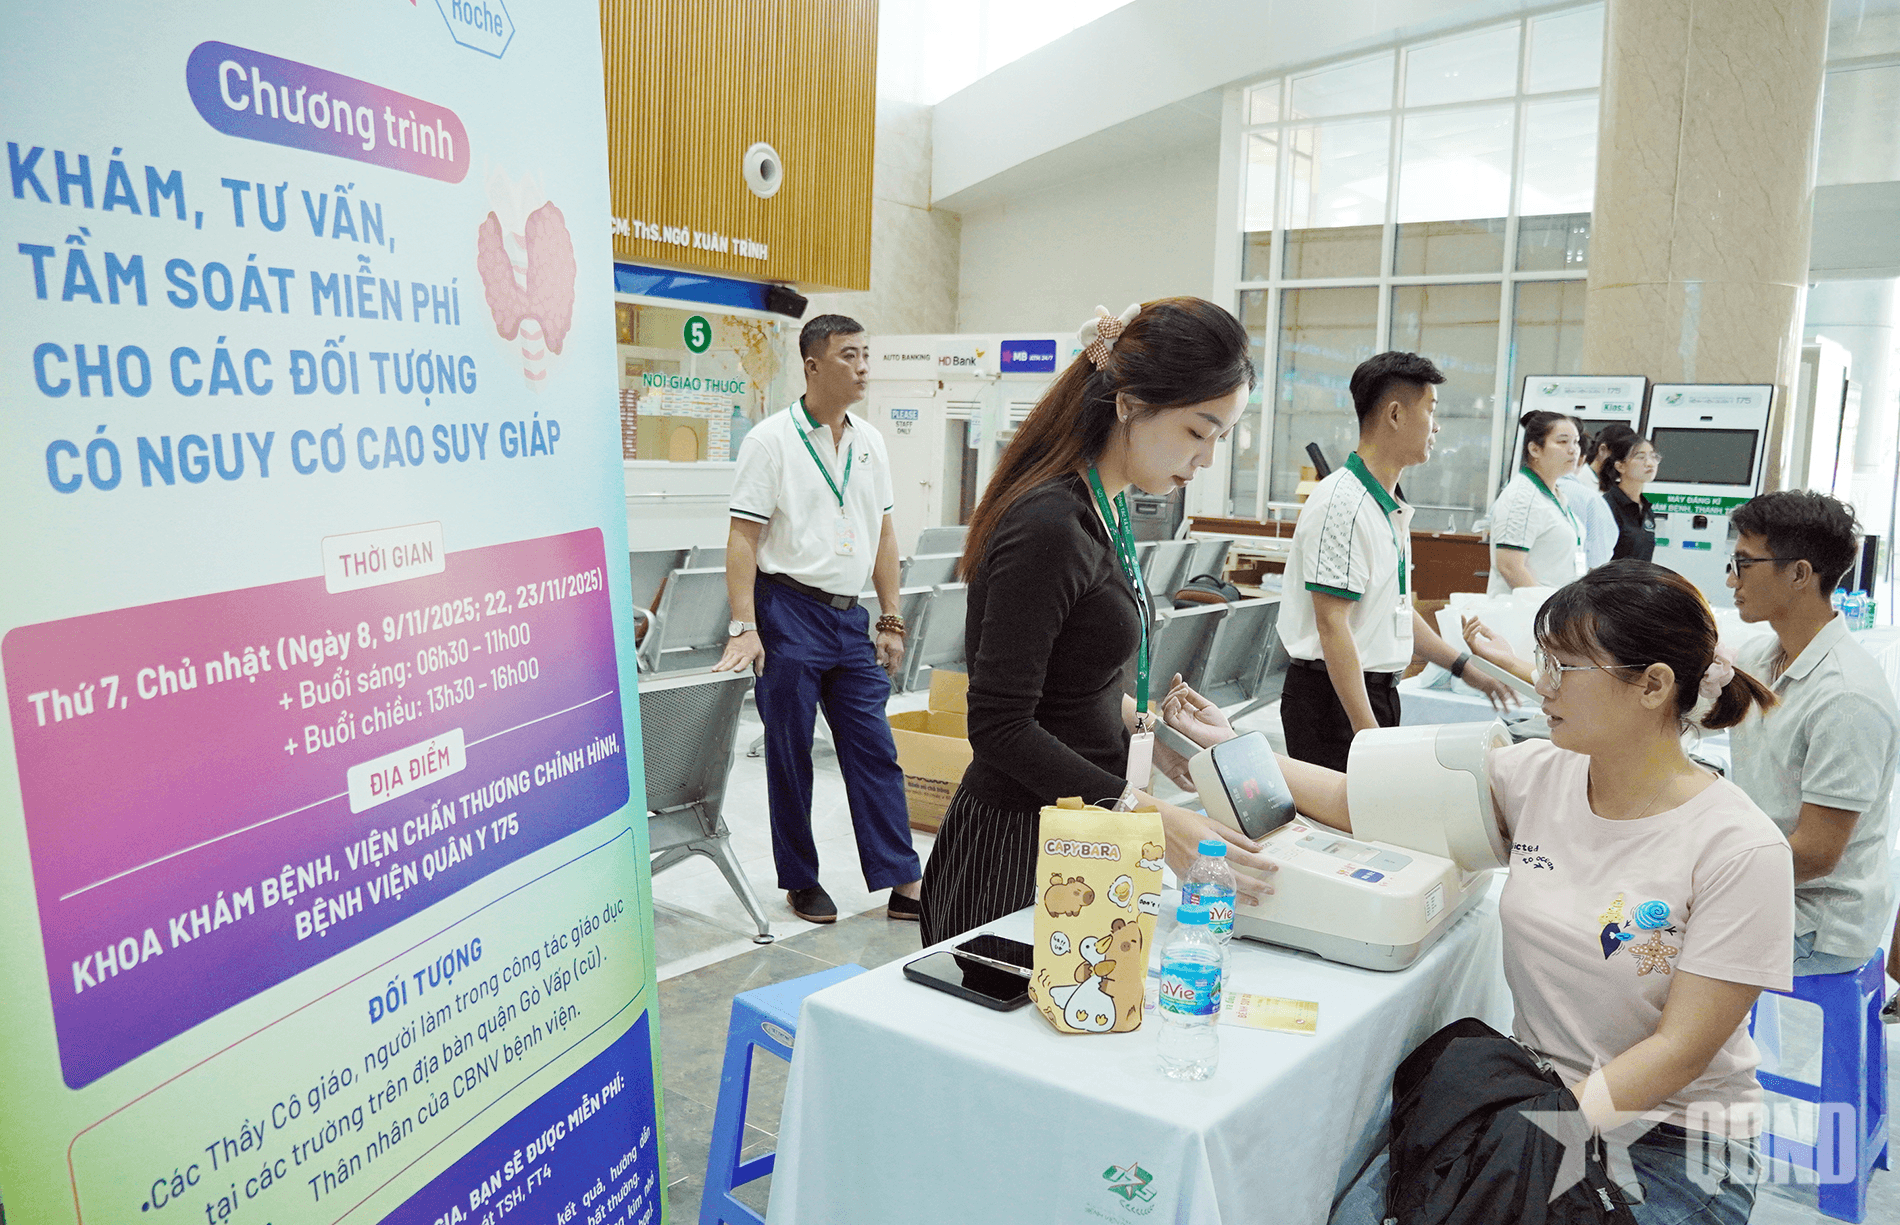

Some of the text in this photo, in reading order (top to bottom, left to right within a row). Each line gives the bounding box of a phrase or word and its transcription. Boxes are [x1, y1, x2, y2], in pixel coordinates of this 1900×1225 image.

[452, 0, 503, 37] Roche
[218, 60, 454, 162] Chương trình
[7, 141, 395, 253] KHÁM, TƯ VẤN,
[18, 226, 461, 326] TẦM SOÁT MIỄN PHÍ
[693, 230, 728, 254] XUÂN
[731, 237, 768, 261] TRÌNH
[33, 335, 477, 407] CHO CÁC ĐỐI TƯỢNG
[691, 322, 705, 348] 5
[1012, 351, 1028, 362] MB
[670, 376, 701, 391] GIAO
[704, 375, 746, 395] THUỐC
[892, 410, 918, 419] PLEASE
[45, 411, 561, 494] CÓ NGUY CƠ CAO SUY GIÁP
[339, 541, 434, 578] THỜI GIAN
[27, 566, 603, 727] Thứ 7, Chủ nhật (Ngày 8, 9/11/2025; 22, 23/11/2025)
[299, 666, 351, 709] Buổi
[357, 661, 412, 693] sáng:
[417, 638, 469, 676] 06h30
[484, 622, 531, 655] 11h00
[304, 710, 356, 754] Buổi
[361, 695, 422, 735] chiều:
[426, 676, 475, 713] 13h30
[490, 656, 540, 692] 16h00
[370, 740, 451, 797] ĐỊA ĐIỂM
[71, 732, 620, 995] KHOA KHÁM BỆNH, VIỆN CHẤN THƯƠNG CHỈNH HÌNH,
[295, 812, 520, 941] BỆNH VIỆN QUÂN Y 175
[1046, 840, 1119, 859] CAPYBARA
[1209, 907, 1233, 919] aVie
[368, 937, 482, 1025] ĐỐI TƯỢNG
[1161, 980, 1195, 1000] aVie
[205, 1119, 265, 1171] Thầy
[271, 1094, 301, 1130] Cô
[307, 1067, 359, 1114] giáo,
[364, 1020, 417, 1073] người
[420, 1004, 452, 1037] làm
[455, 974, 500, 1014] trong
[502, 949, 541, 983] công
[543, 934, 568, 958] tác
[571, 915, 600, 948] giáo
[602, 899, 624, 923] dục
[205, 1183, 238, 1225] tại
[245, 1161, 287, 1199] các
[291, 1105, 364, 1166] trường
[368, 1075, 408, 1115] trên
[412, 1054, 439, 1085] địa
[442, 1031, 474, 1065] bàn
[477, 1004, 517, 1043] quận
[519, 986, 541, 1012] Gò
[543, 967, 571, 997] Vấp
[307, 1004, 581, 1202] Thân nhân của CBNV bệnh viện.
[469, 1169, 502, 1212] BẠN
[503, 1149, 524, 1181] SẼ
[526, 1121, 566, 1164] ĐƯỢC
[567, 1093, 600, 1132] MIỄN
[602, 1071, 625, 1105] PHÍ:
[495, 1185, 526, 1219] TSH,
[526, 1163, 552, 1194] FT4
[582, 1177, 606, 1208] quả,
[627, 1194, 643, 1219] kim
